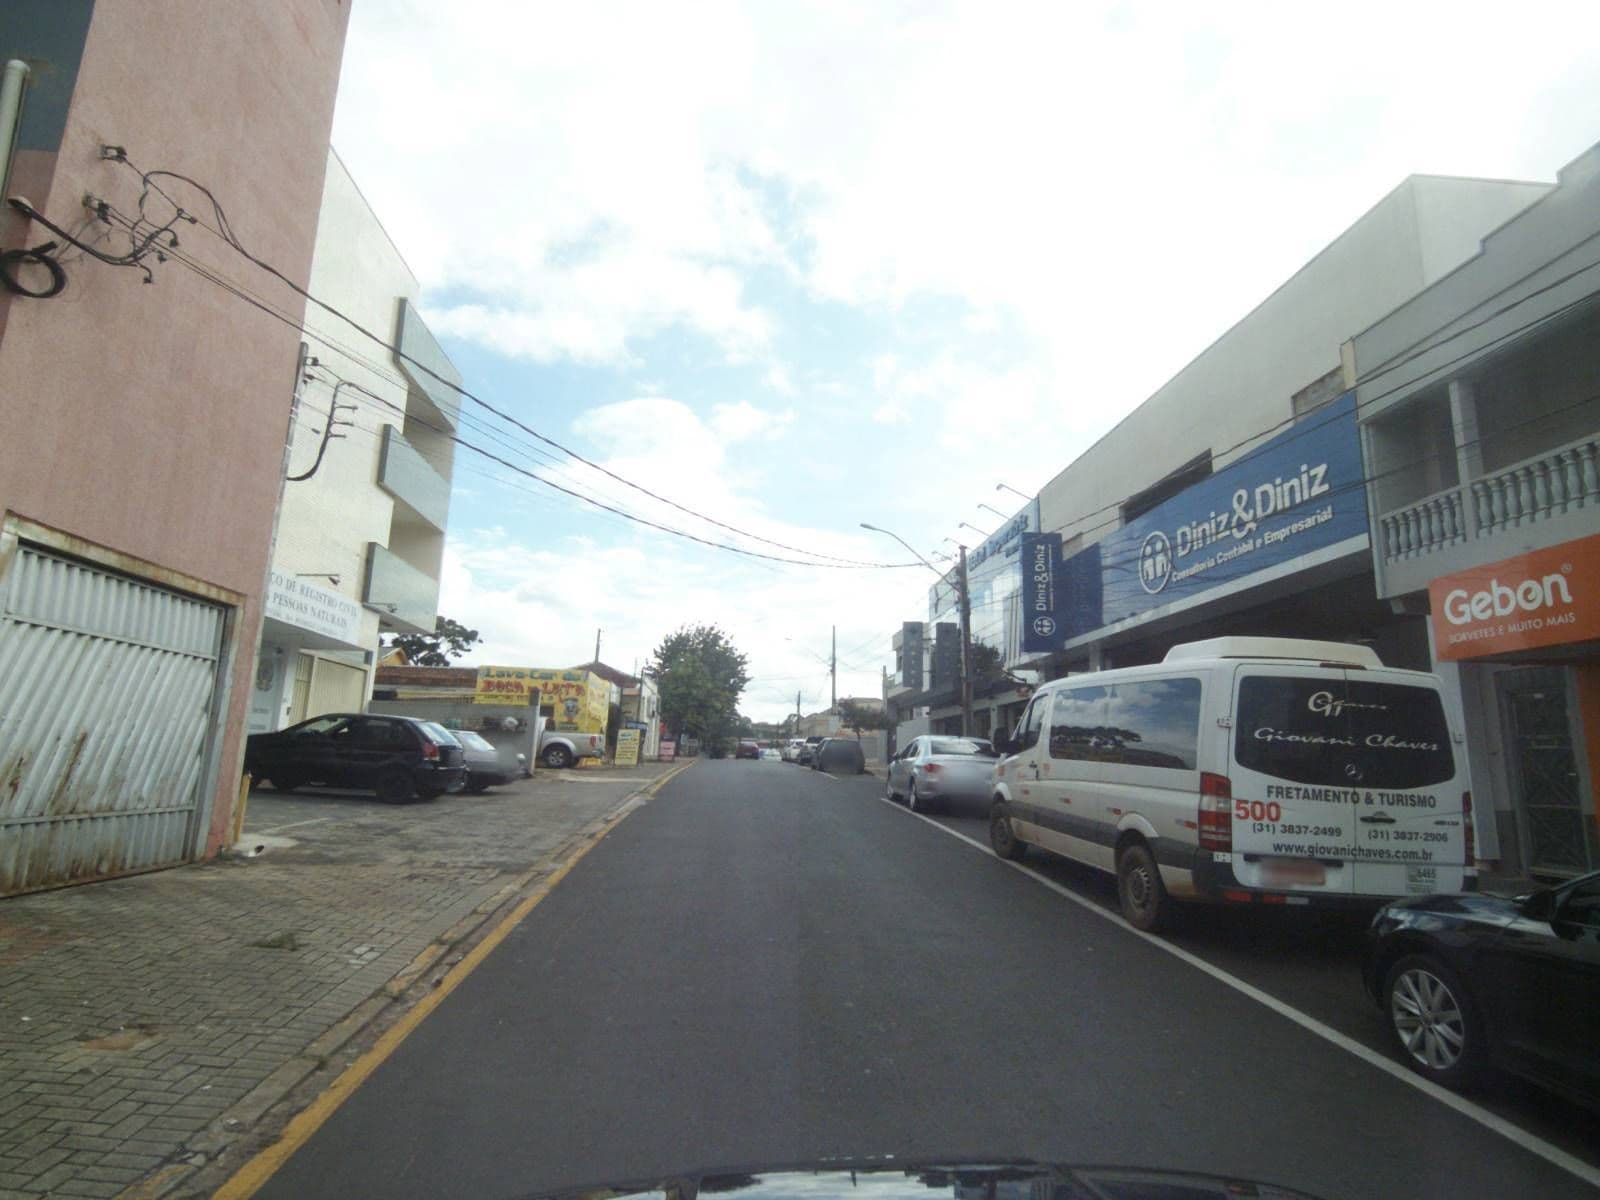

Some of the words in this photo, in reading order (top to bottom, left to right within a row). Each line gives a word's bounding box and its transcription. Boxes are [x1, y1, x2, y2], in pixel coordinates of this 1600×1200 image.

[1263, 505, 1333, 545] Empresarial
[272, 592, 308, 614] PESSOAS
[1444, 573, 1573, 625] Gebon
[1449, 627, 1496, 645] SORVETES
[1508, 617, 1543, 634] MUITO
[1546, 611, 1577, 626] MAIS
[1253, 727, 1355, 747] Giovani
[1365, 734, 1439, 752] Chaves
[1266, 785, 1360, 804] FRETAMENTO
[1364, 796, 1374, 805] &
[1377, 792, 1437, 809] TURISMO
[1235, 800, 1282, 823] 500
[1252, 823, 1276, 835] (31)
[1280, 825, 1342, 838] 3837-2499
[1367, 831, 1390, 841] (31)
[1272, 841, 1433, 861] www.giovanichaves.com.br
